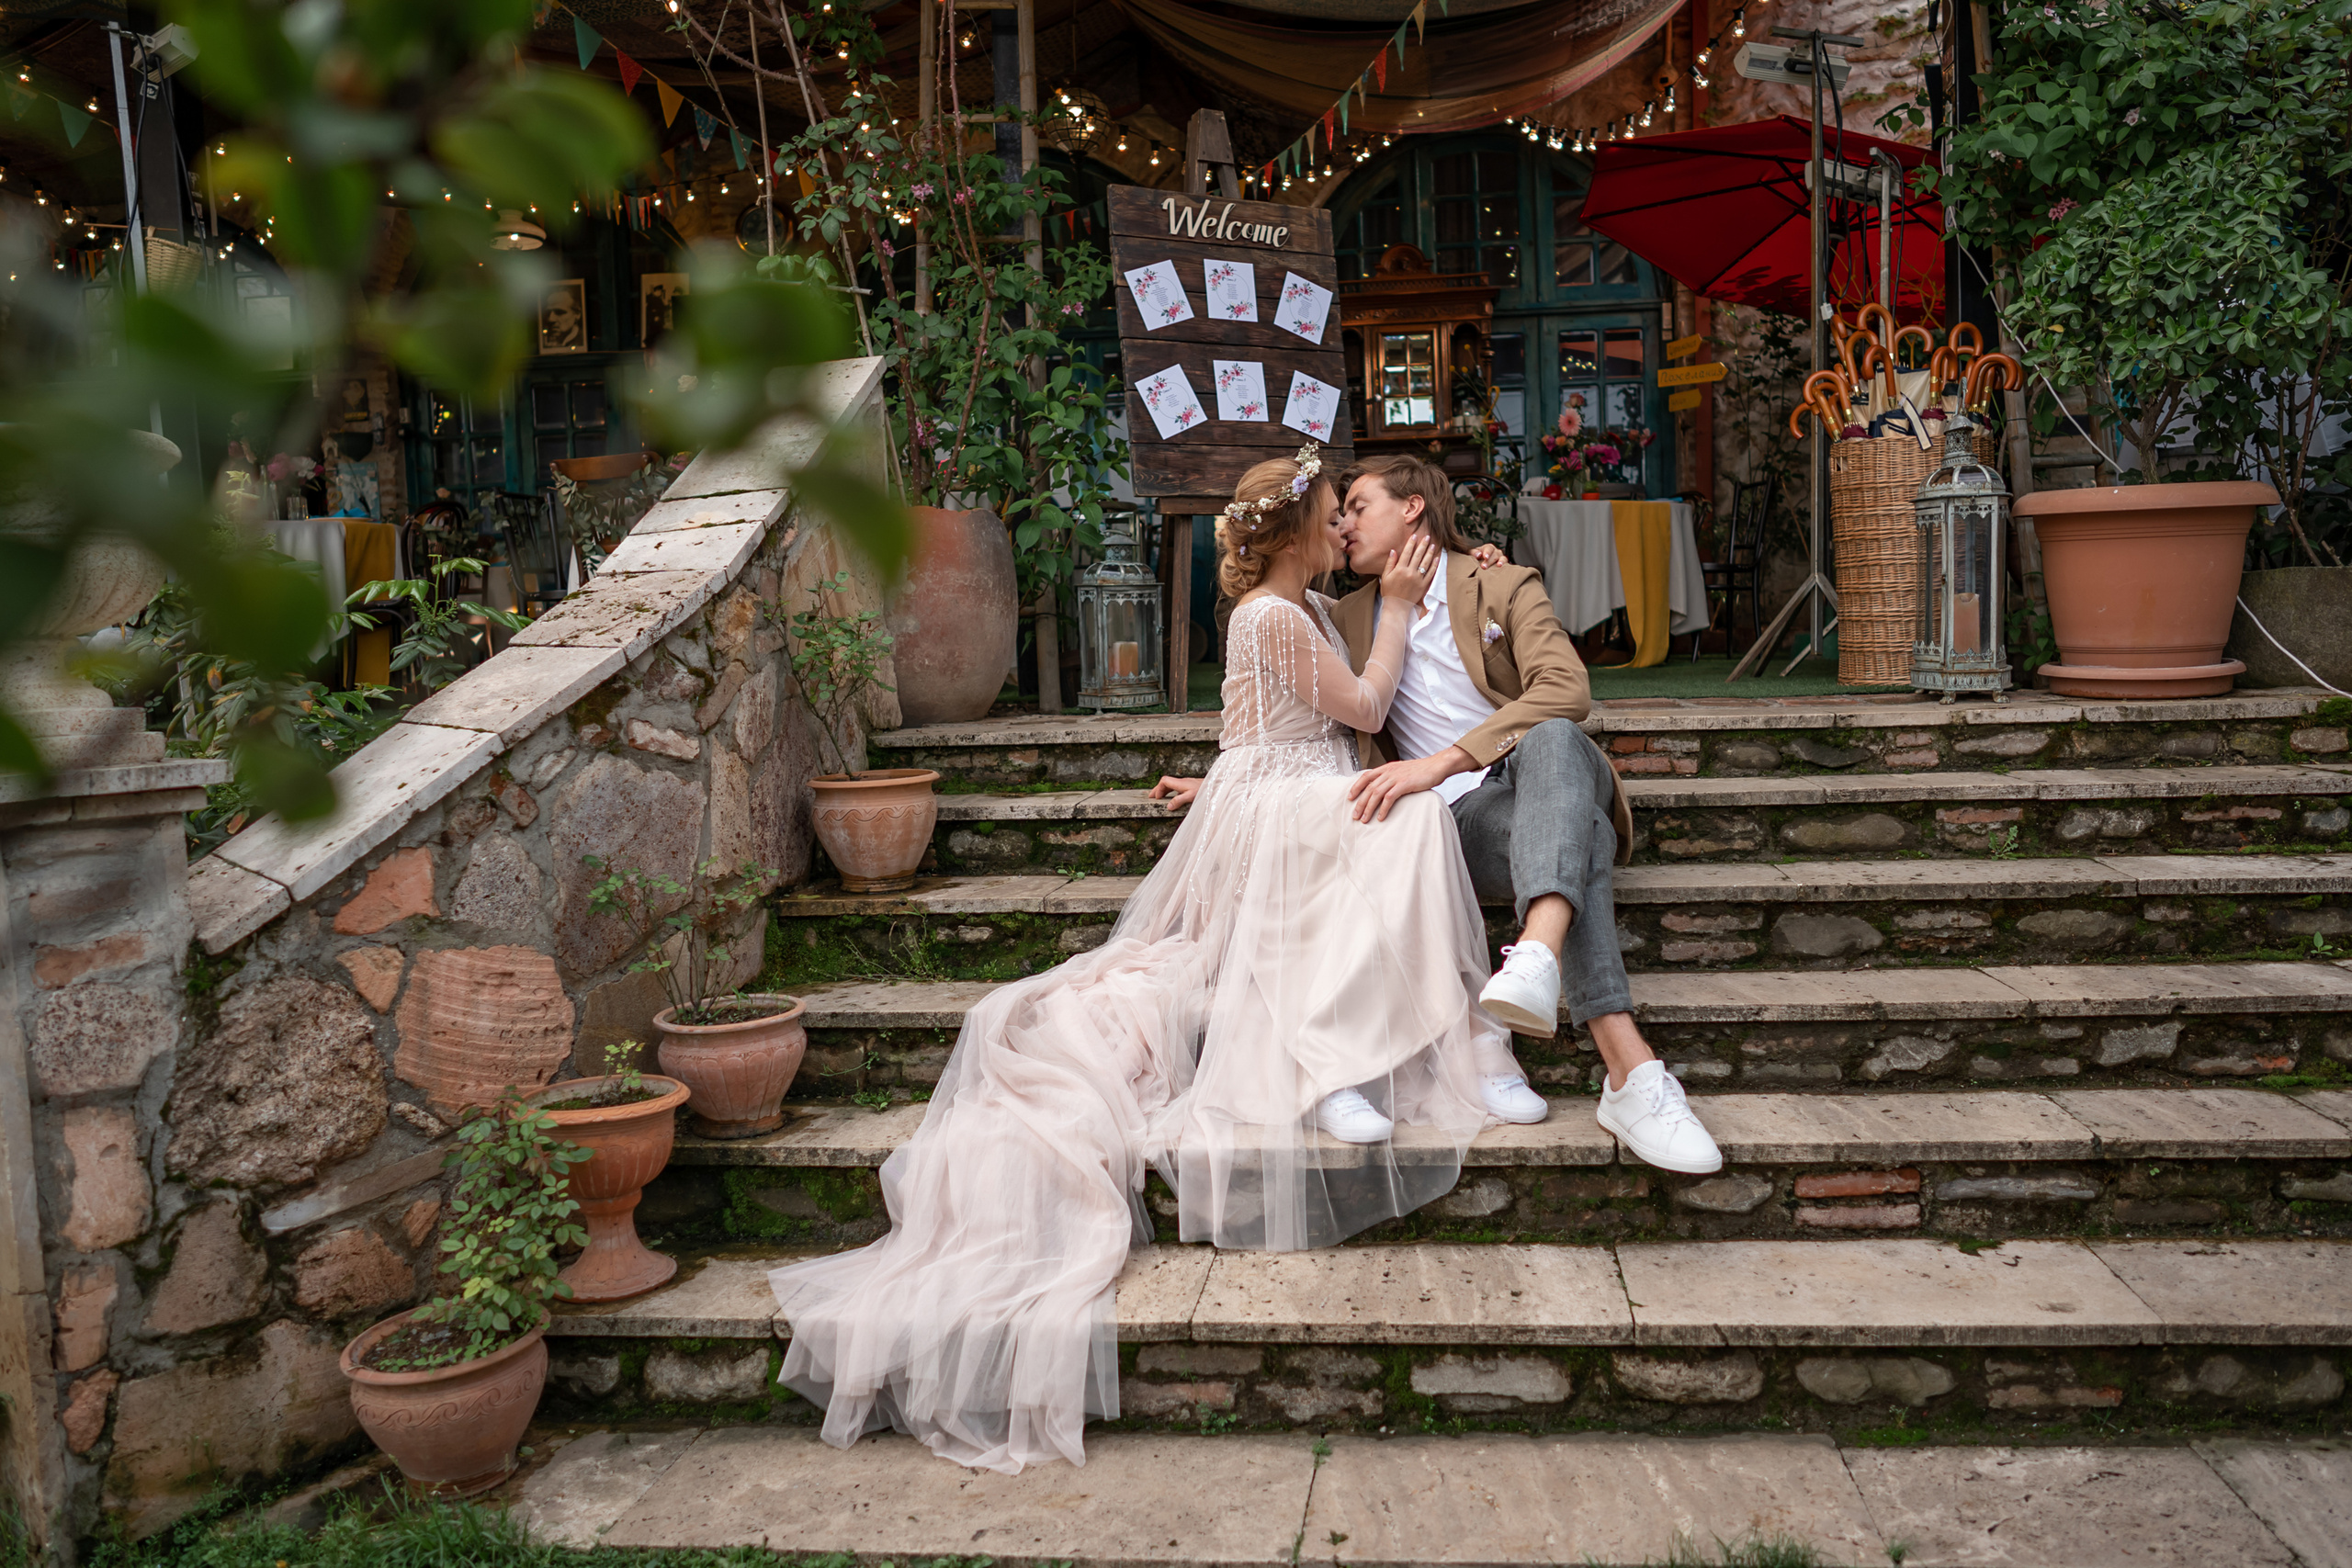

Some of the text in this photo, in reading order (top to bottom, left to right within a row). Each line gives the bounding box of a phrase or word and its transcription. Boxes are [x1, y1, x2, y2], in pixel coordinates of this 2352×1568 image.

[1161, 197, 1290, 248] Welcome
[1660, 368, 1724, 383] Пожелания
[1482, 386, 1500, 423] 2
